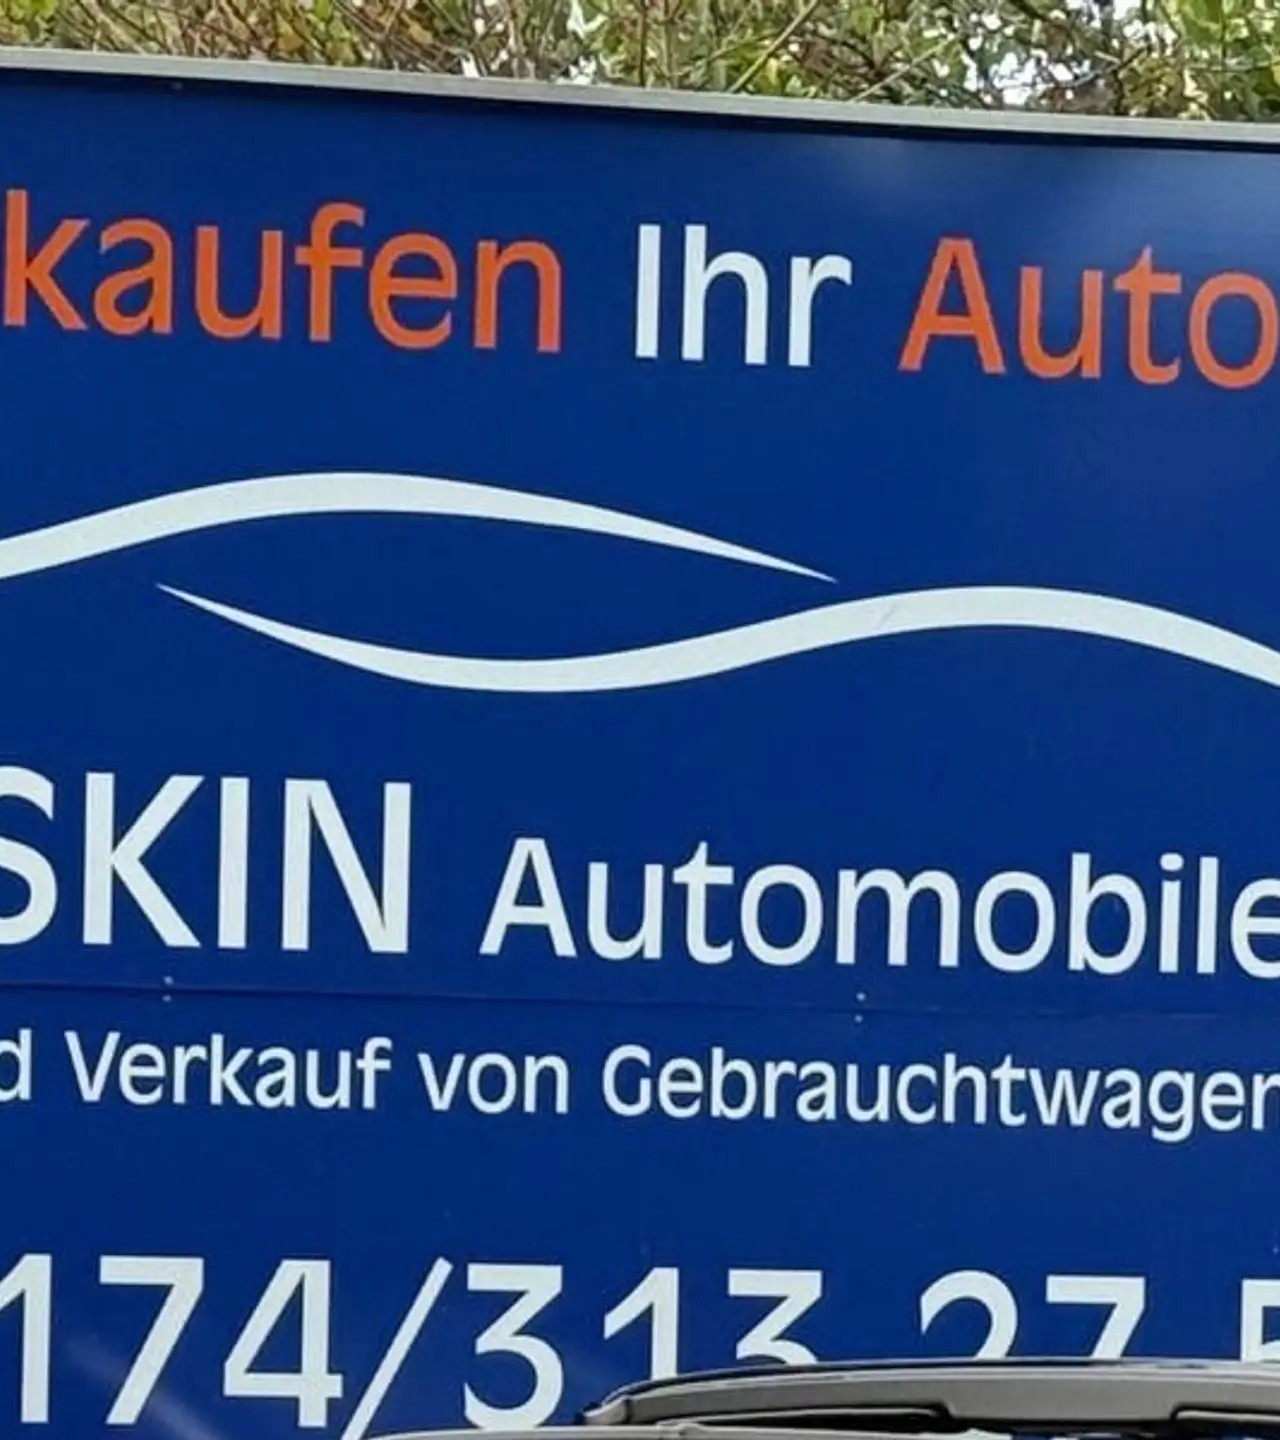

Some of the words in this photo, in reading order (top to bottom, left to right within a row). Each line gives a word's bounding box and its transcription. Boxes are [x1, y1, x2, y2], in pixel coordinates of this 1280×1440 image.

[5, 191, 561, 351] kaufen
[637, 226, 851, 366] Ihr
[901, 239, 1279, 388] Auto
[66, 1031, 392, 1109] Verkauf
[418, 1053, 568, 1113] von
